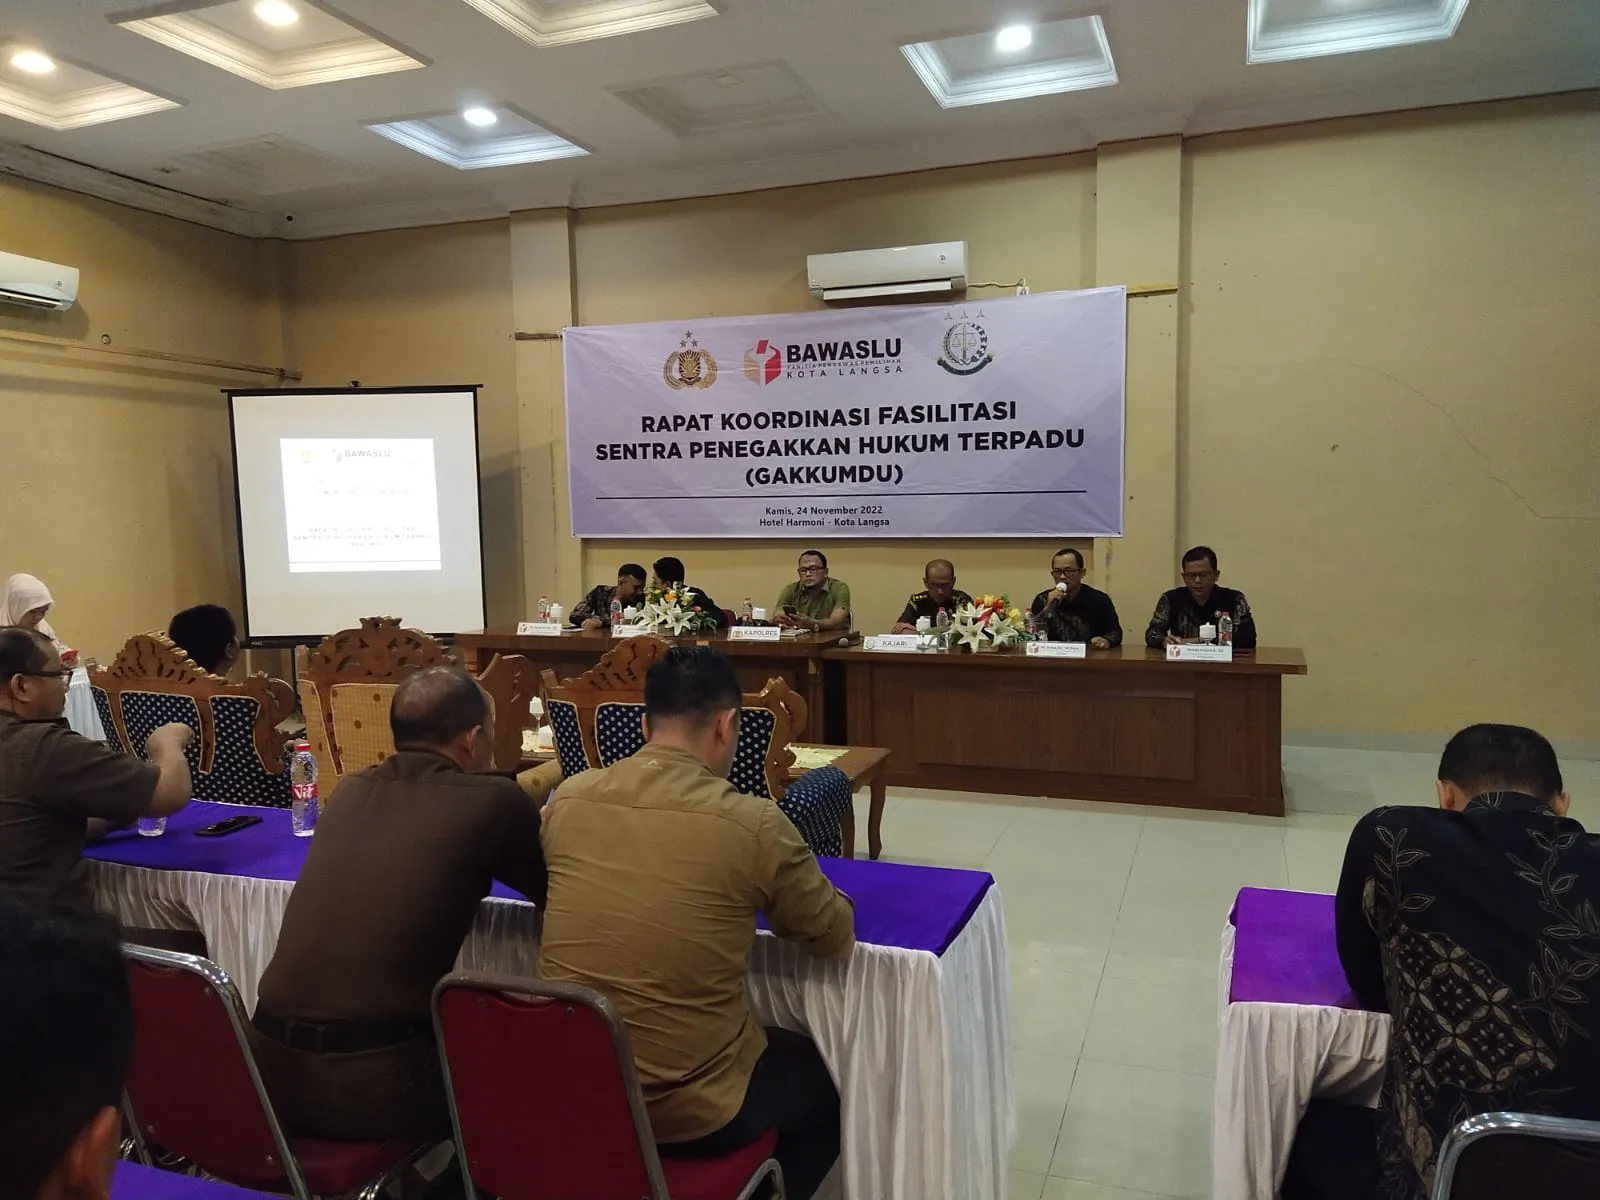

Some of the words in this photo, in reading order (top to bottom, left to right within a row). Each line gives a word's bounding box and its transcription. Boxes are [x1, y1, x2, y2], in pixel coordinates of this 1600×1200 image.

[787, 338, 902, 363] BAWASLU
[787, 370, 827, 379] KOTA
[839, 366, 903, 376] LANGSA
[641, 414, 713, 433] RAPAT
[721, 407, 870, 431] KOORDINASI
[879, 401, 1016, 424] FASILITASI
[596, 442, 683, 461] SENTRA
[690, 436, 850, 459] PENEGAKKAN
[859, 433, 949, 454] HUKUM
[958, 429, 1085, 451] TERPADU
[745, 464, 904, 488] (GAKKUMDU)
[759, 518, 783, 527] Hotel
[786, 517, 825, 527] Harmoni
[834, 517, 855, 526] Kota
[858, 517, 890, 528] Langsa
[765, 506, 794, 516] Kamis,
[797, 506, 808, 515] 24
[810, 505, 858, 515] November
[860, 505, 883, 514] 2022
